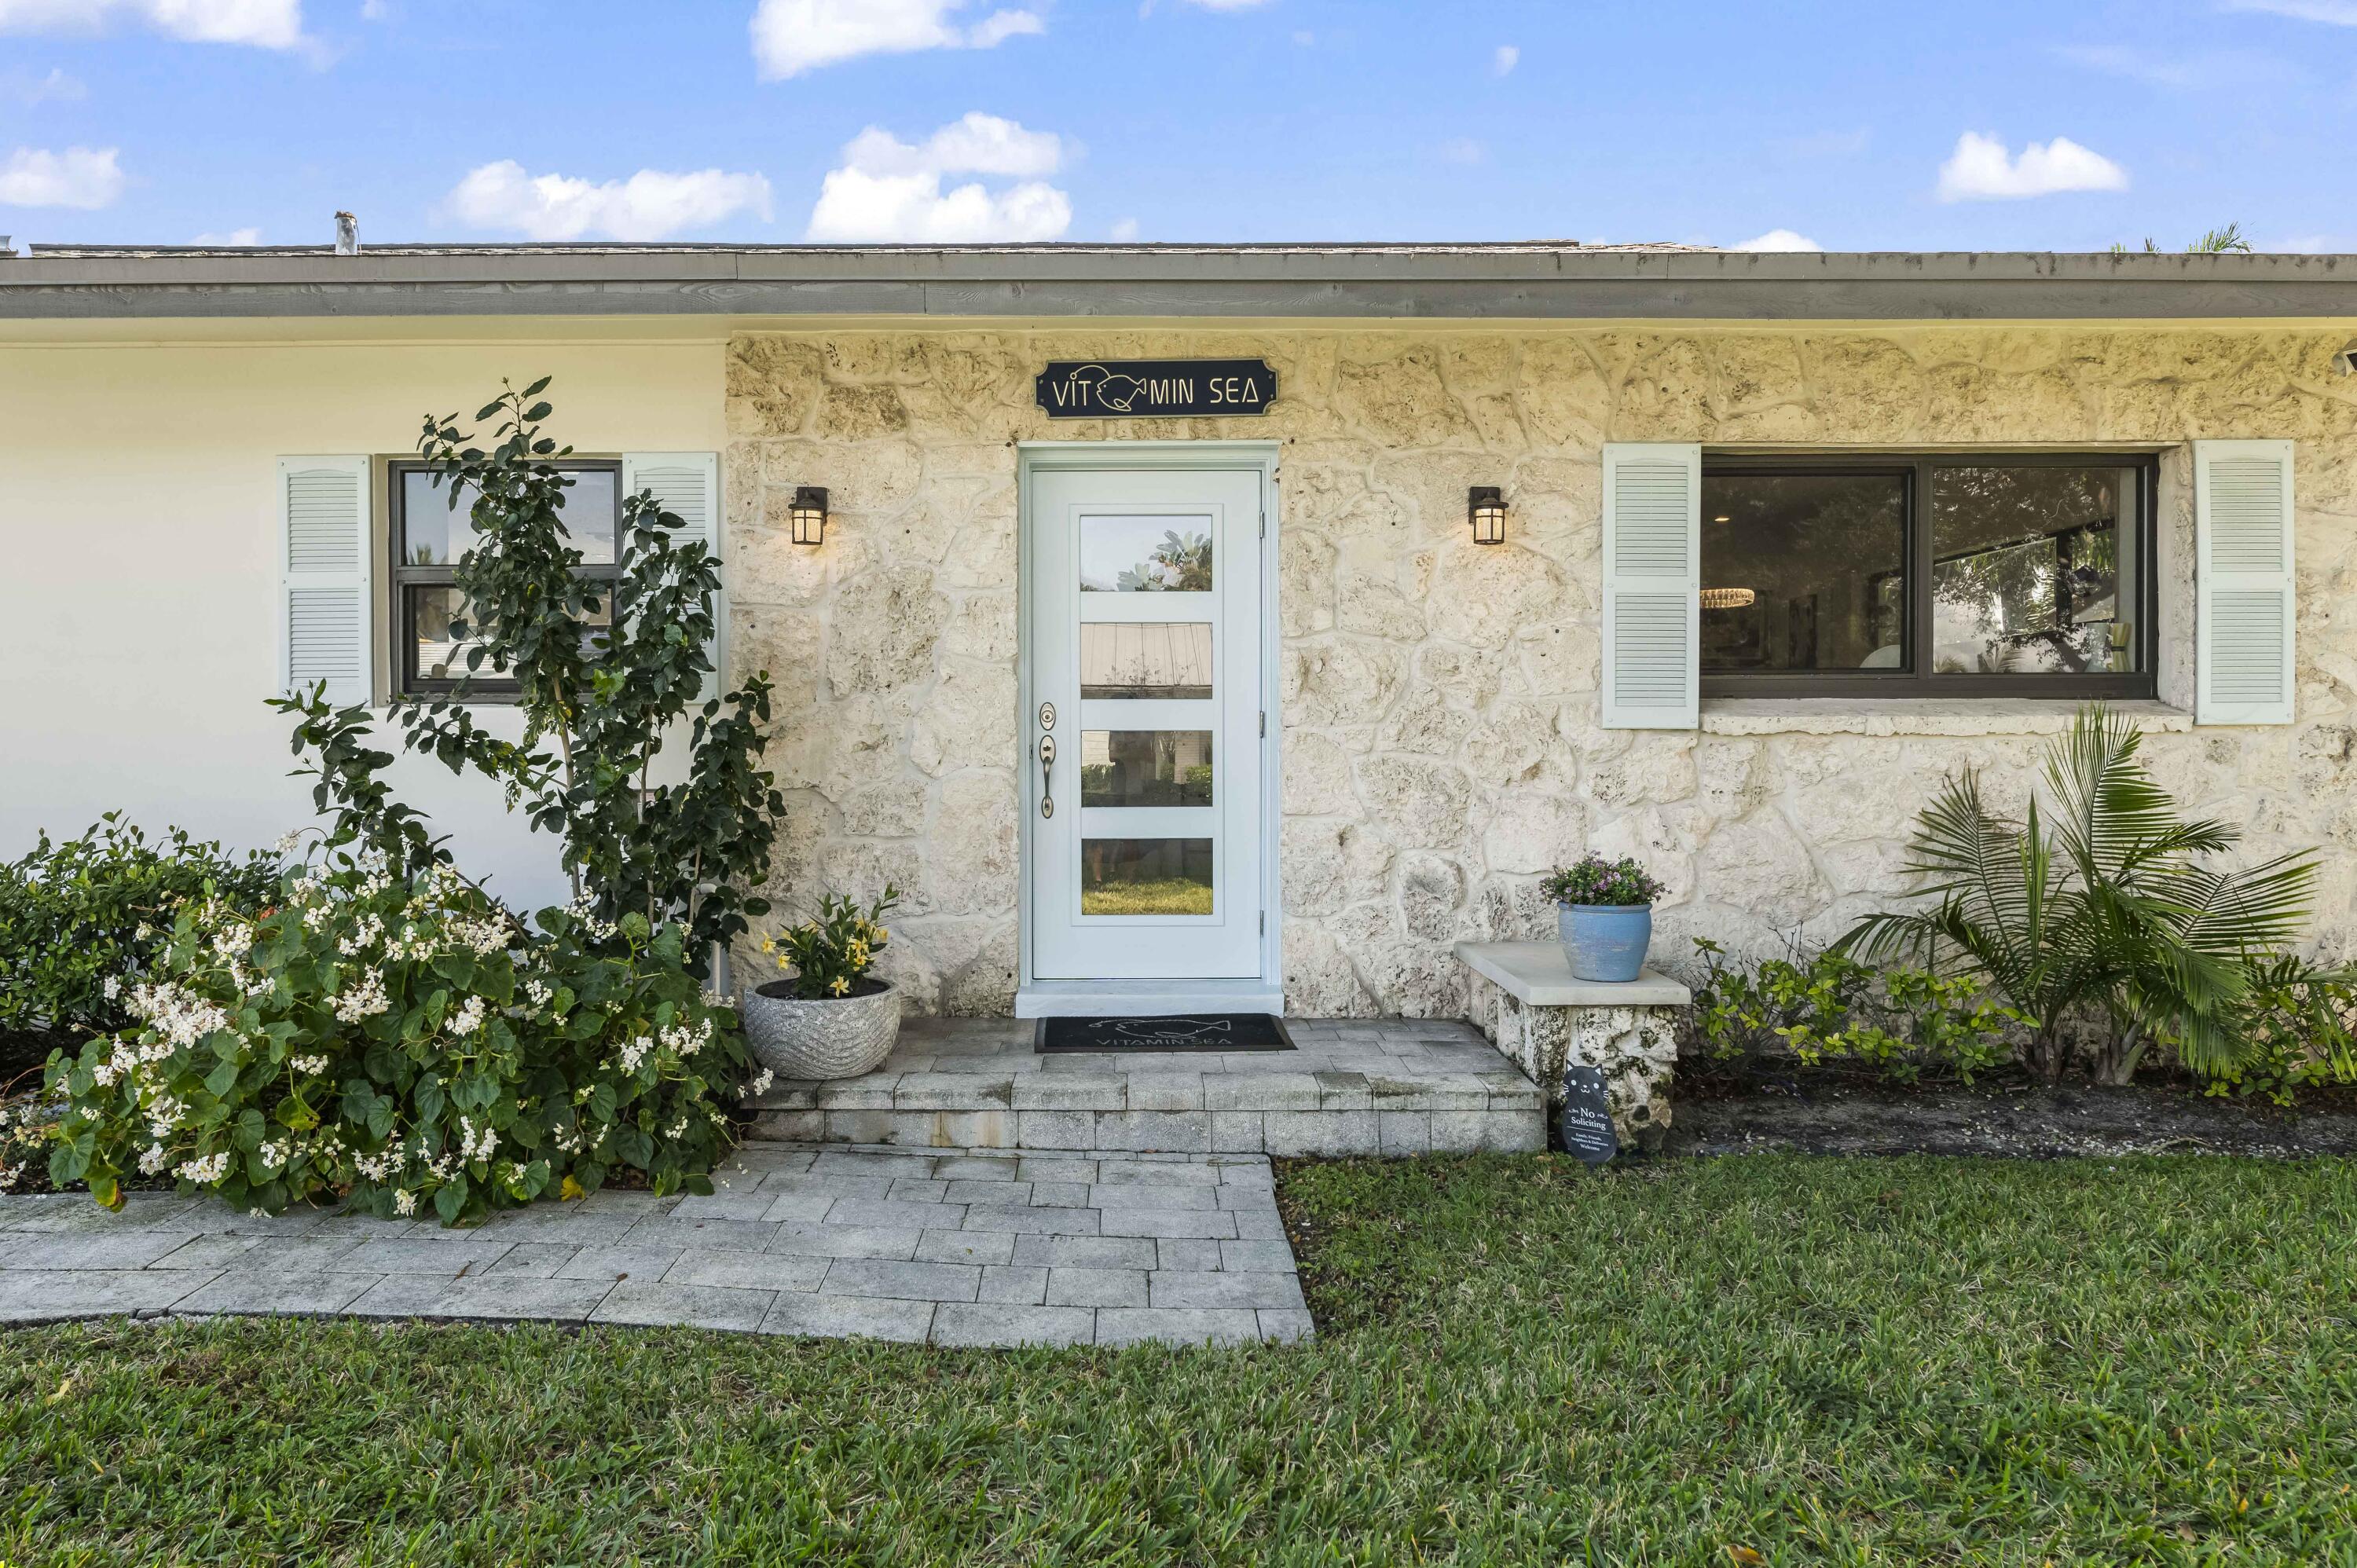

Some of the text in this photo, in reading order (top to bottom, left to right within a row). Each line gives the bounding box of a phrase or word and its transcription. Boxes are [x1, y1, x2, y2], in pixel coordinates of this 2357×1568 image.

[1209, 377, 1259, 404] SEA
[1580, 1107, 1595, 1119] No
[1571, 1116, 1607, 1131] Soliciting
